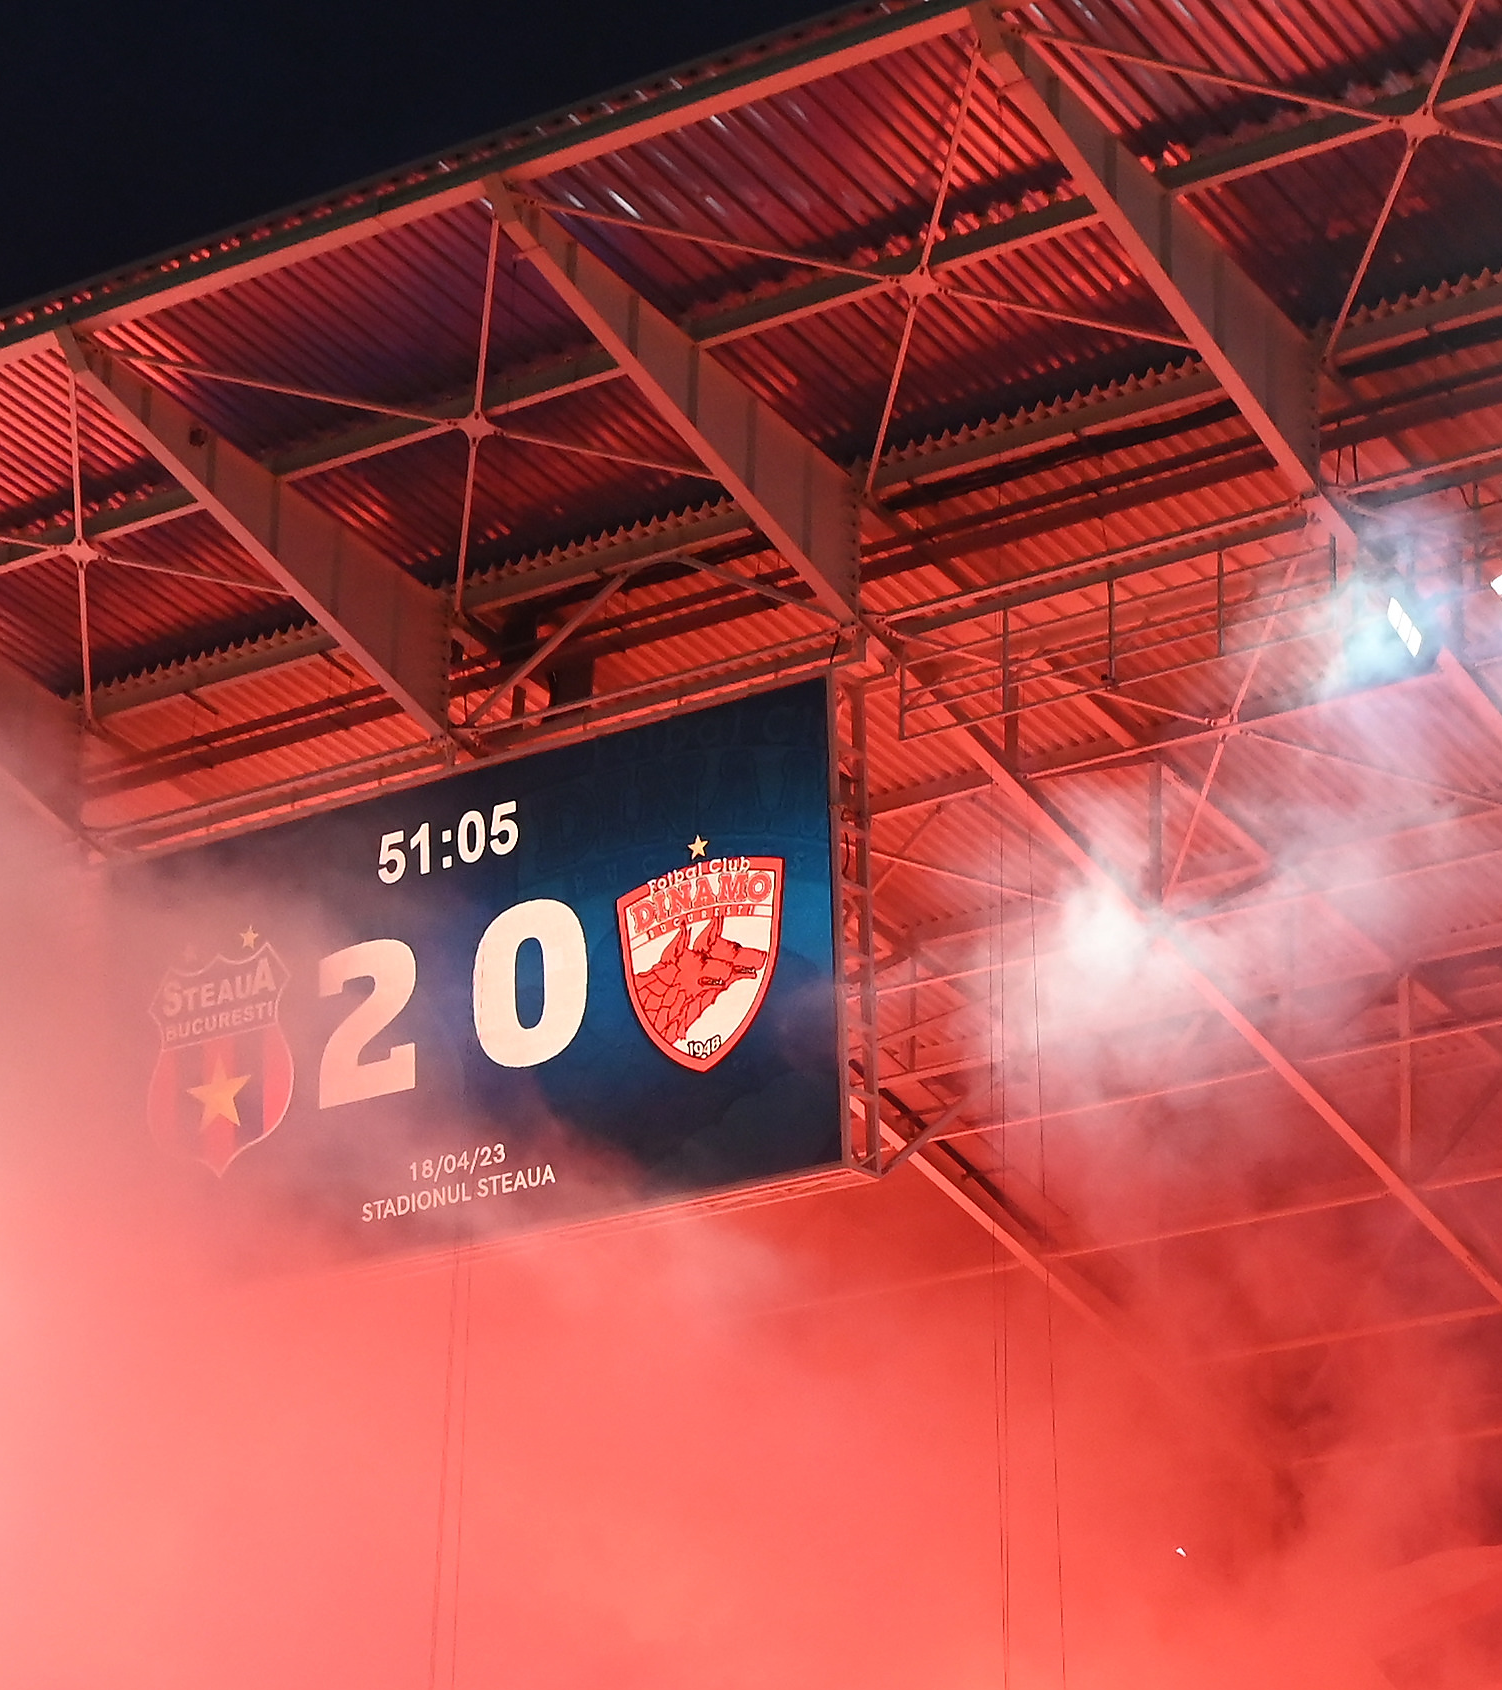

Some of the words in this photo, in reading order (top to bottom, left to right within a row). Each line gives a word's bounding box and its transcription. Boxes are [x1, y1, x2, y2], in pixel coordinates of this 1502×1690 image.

[378, 801, 520, 886] 51:05
[630, 872, 772, 934] DINAMO
[648, 864, 703, 894] Fotbal
[709, 857, 751, 873] Club
[161, 957, 277, 1017] STEAUA
[472, 899, 588, 1069] 0
[165, 1001, 273, 1043] BUCURESTI
[318, 939, 417, 1109] 2
[687, 1035, 722, 1058] 1948
[409, 1143, 507, 1182] 18/04/23
[361, 1183, 472, 1223] STADIONUL
[476, 1164, 556, 1198] STEAUA
